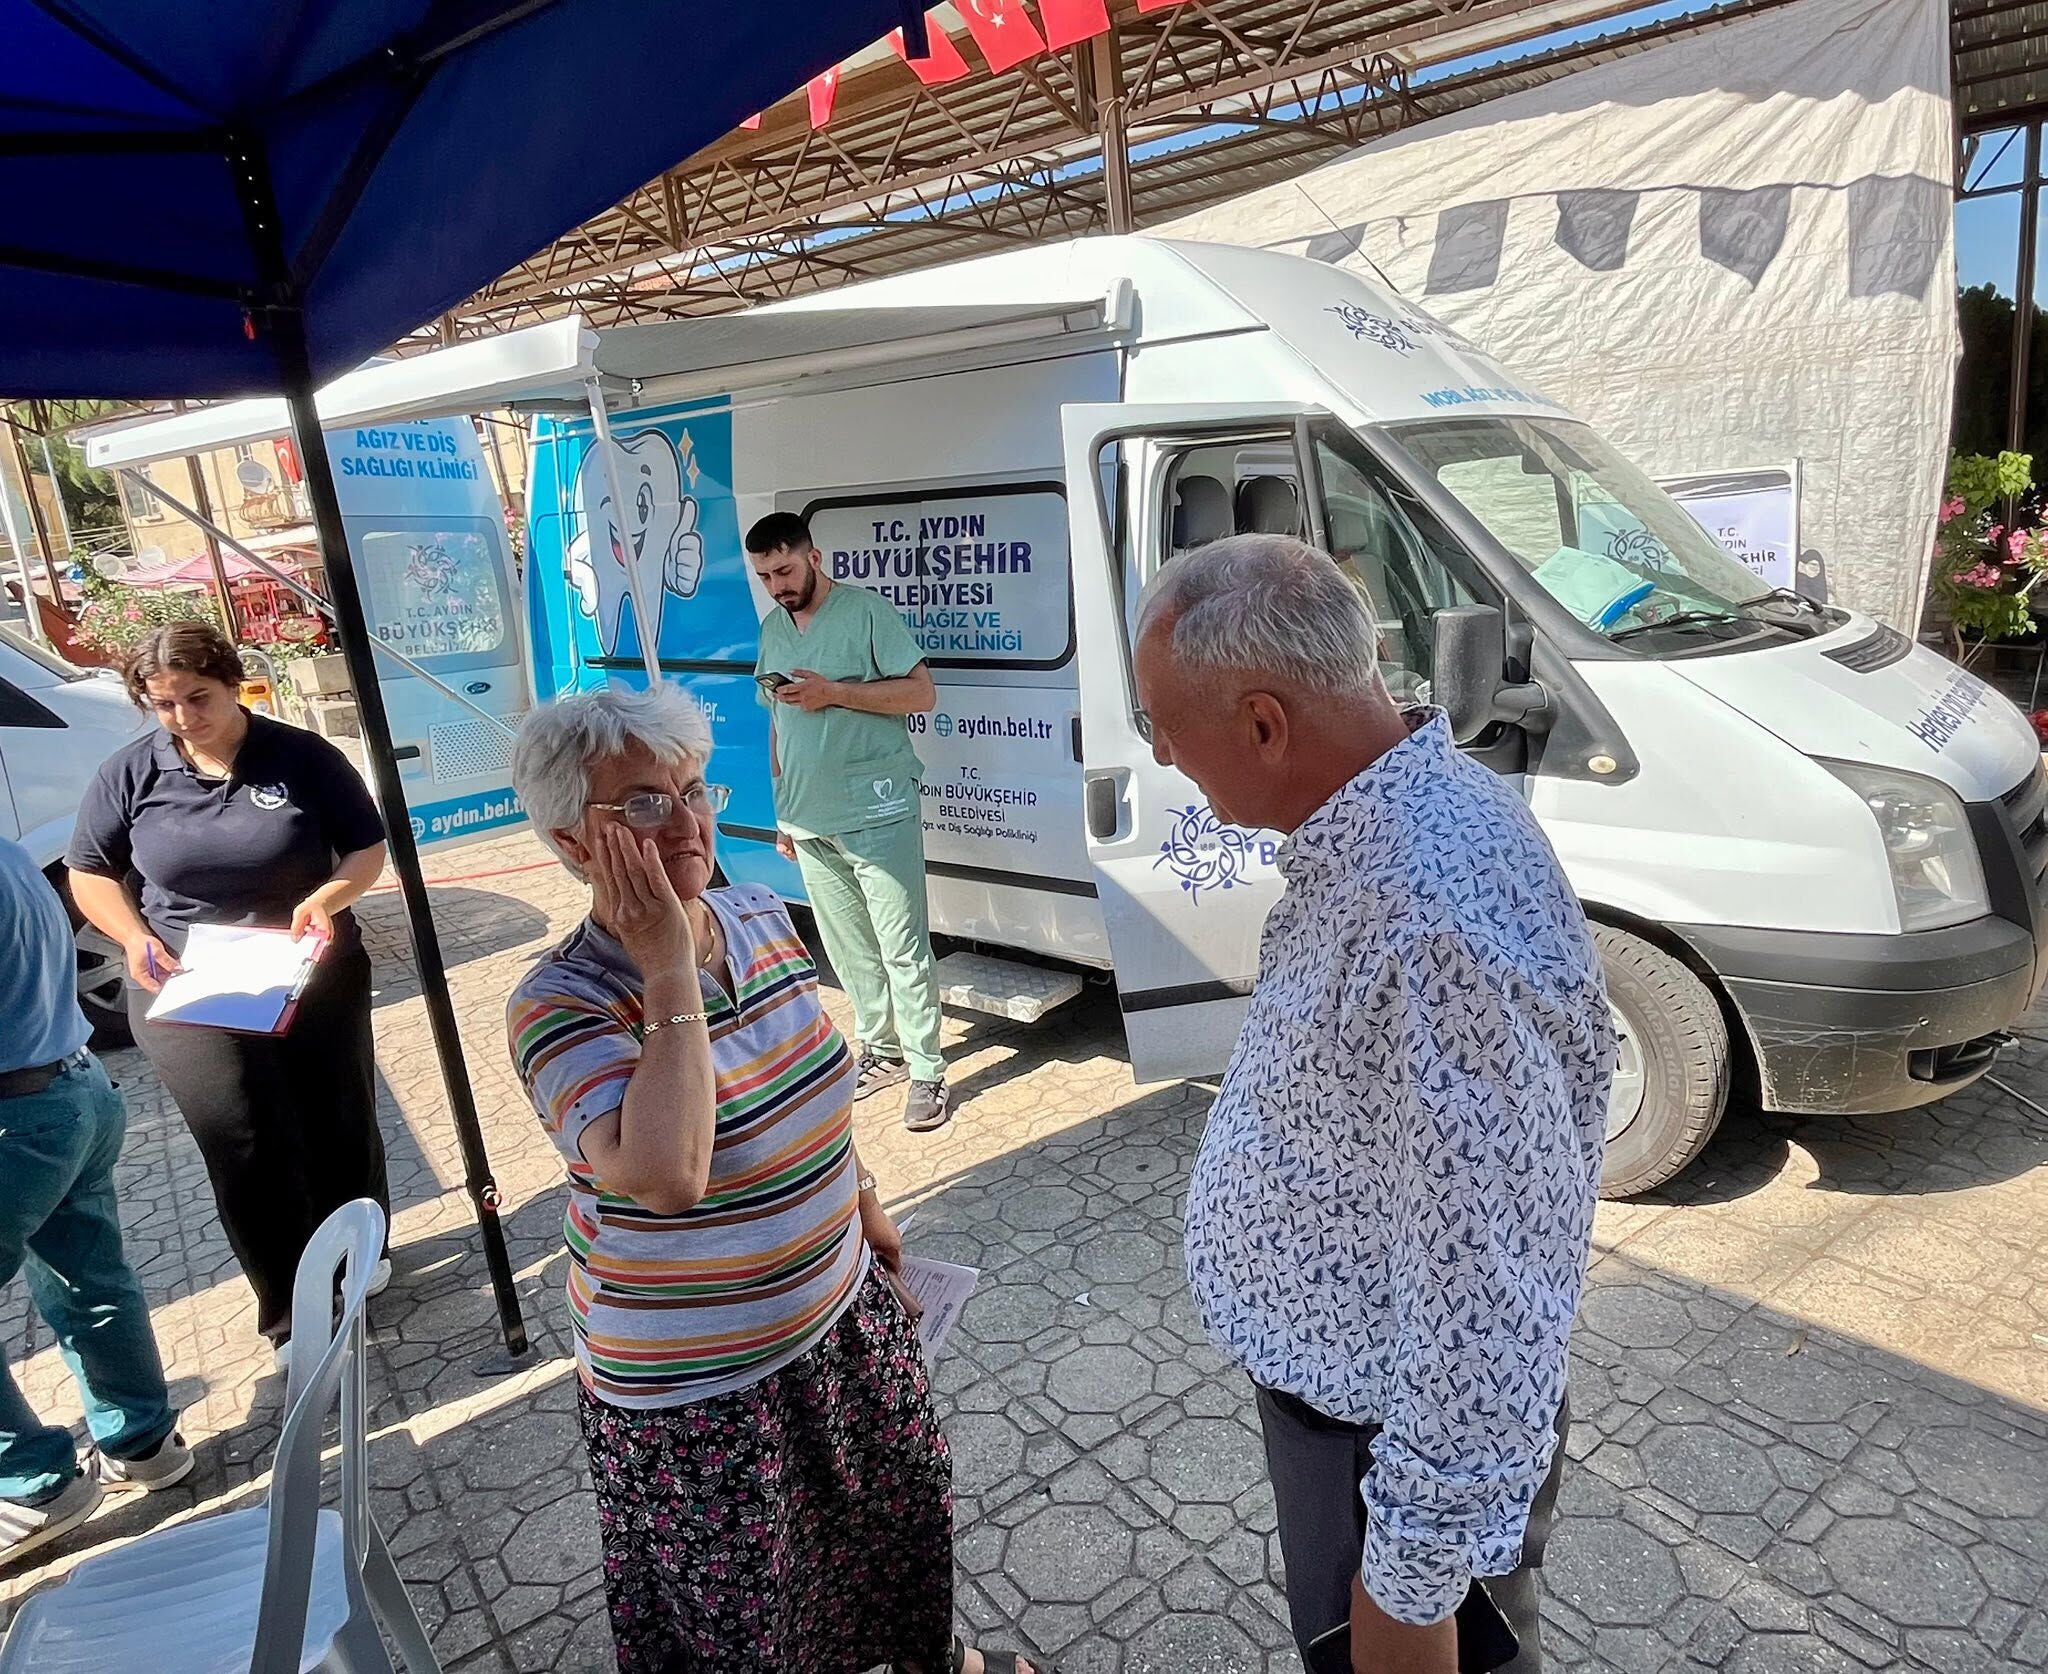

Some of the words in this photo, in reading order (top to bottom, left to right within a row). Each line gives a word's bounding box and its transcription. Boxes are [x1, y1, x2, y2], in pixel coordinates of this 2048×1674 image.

[356, 429, 399, 449] AĞIZ
[401, 433, 425, 451] VE
[427, 431, 456, 456] DİŞ
[341, 456, 414, 477] SAĞLIĞI
[417, 458, 478, 480] KLİNİĞİ
[872, 520, 911, 543] T.C.
[919, 514, 985, 541] AYDIN
[1721, 540, 1747, 549] DIN
[832, 541, 1032, 581] BÜYÜKŞEHİR
[973, 612, 1001, 629] VE
[950, 630, 1022, 651] KLİNİĞİ
[957, 715, 1053, 739] aydın.bel.tr
[1905, 706, 1961, 753] Herkes
[920, 784, 942, 797] DIN
[945, 782, 1037, 807] BÜYÜKŞEHİR
[939, 804, 1006, 823] BELEDİYESİ
